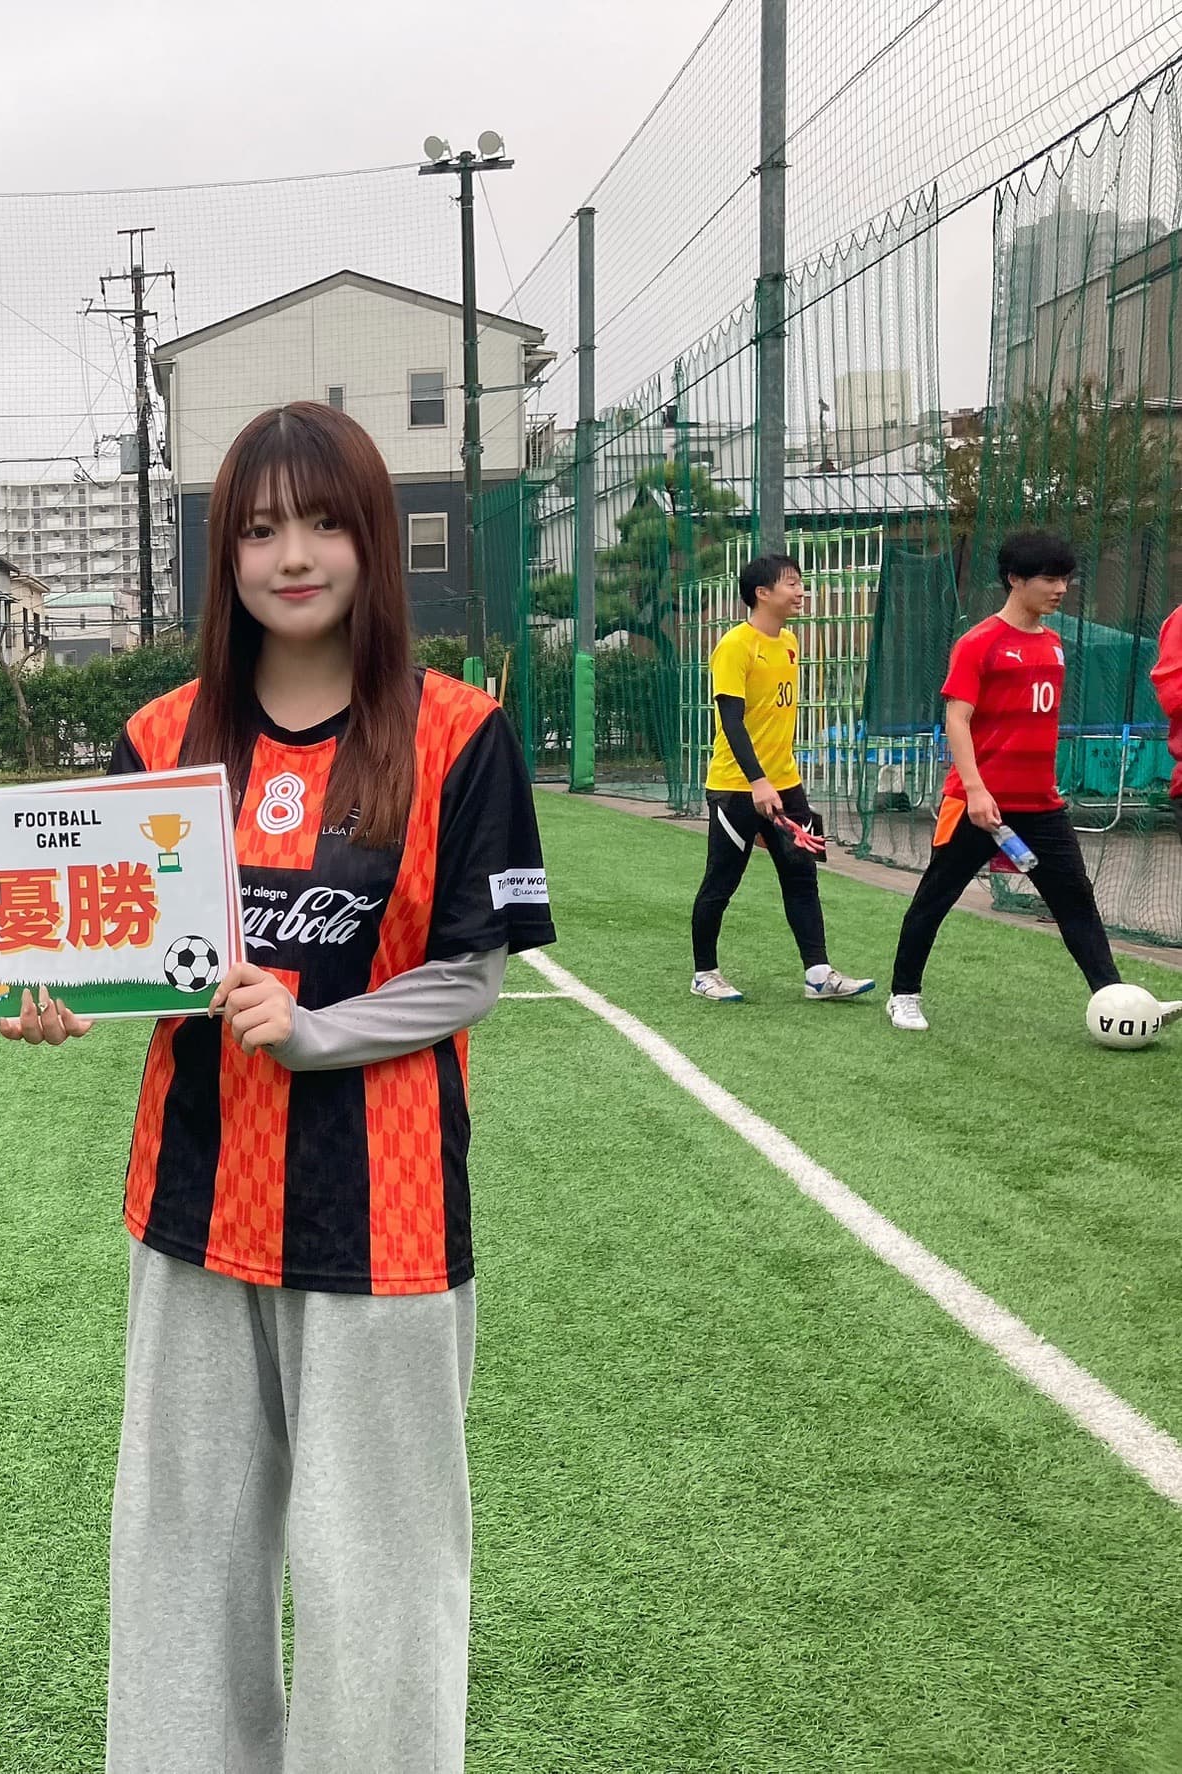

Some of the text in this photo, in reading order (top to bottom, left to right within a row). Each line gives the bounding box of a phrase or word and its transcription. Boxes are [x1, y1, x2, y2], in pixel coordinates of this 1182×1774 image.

[776, 681, 793, 707] 30
[1031, 681, 1055, 713] 10
[256, 771, 306, 835] 8
[14, 809, 102, 828] FOOTBALL
[36, 831, 82, 848] GAME
[253, 886, 288, 901] alegre
